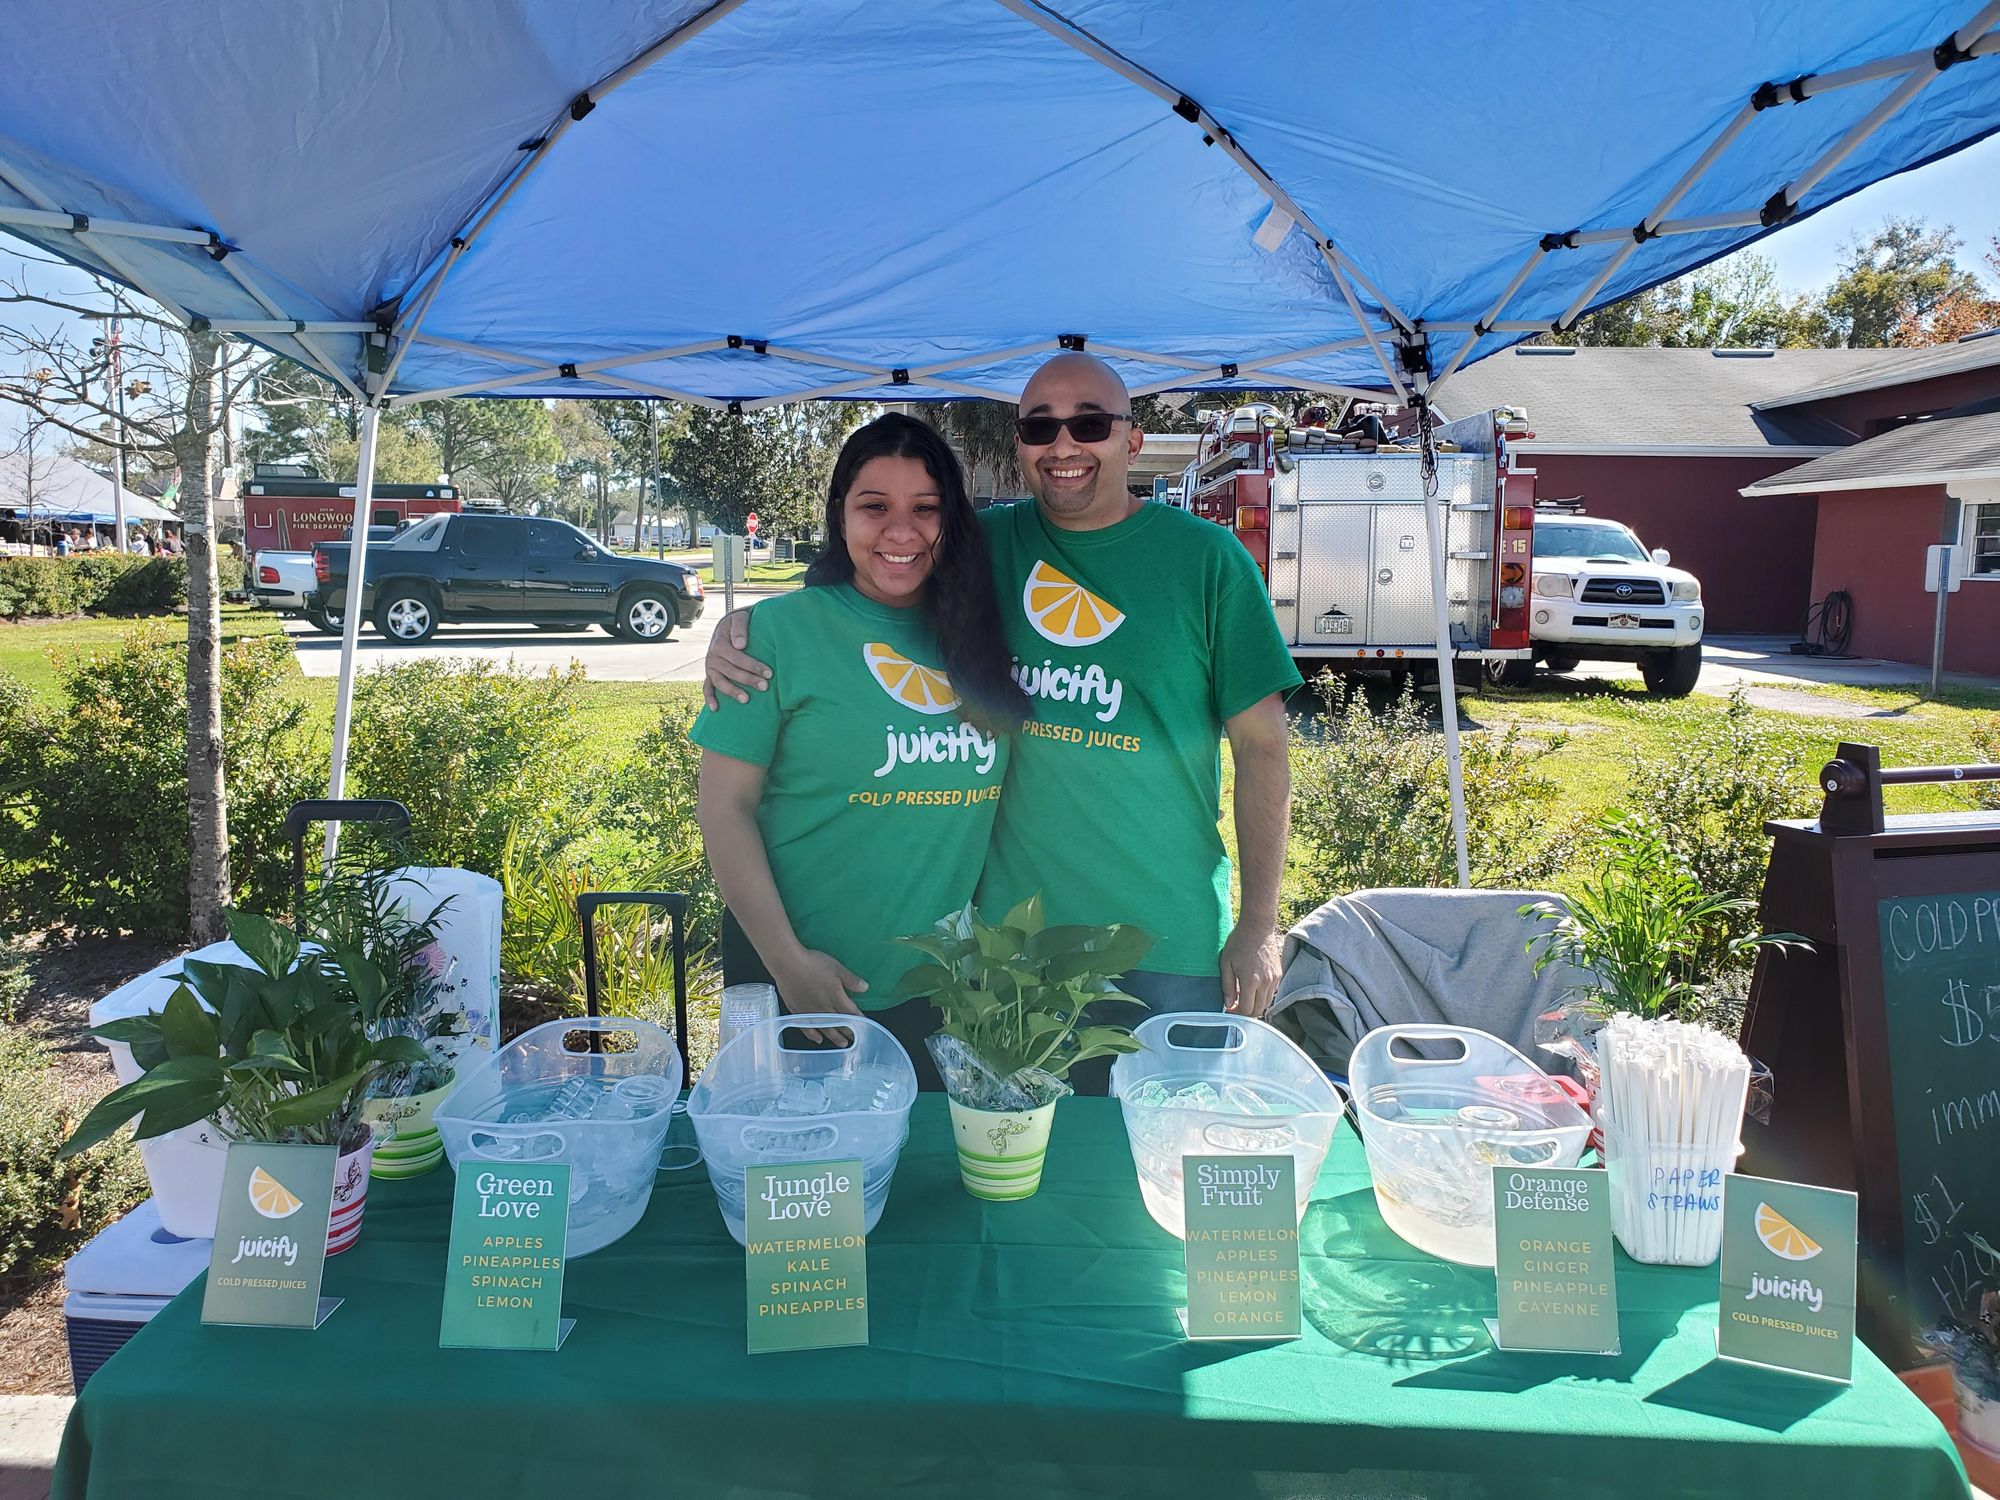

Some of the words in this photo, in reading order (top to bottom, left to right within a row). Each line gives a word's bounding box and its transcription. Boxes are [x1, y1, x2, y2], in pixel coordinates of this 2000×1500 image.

[293, 512, 353, 523] LONGWOO
[1022, 719, 1084, 744] PRESSED
[1085, 730, 1141, 752] JUICES
[873, 721, 996, 778] juicify
[848, 791, 893, 807] COLD
[895, 790, 963, 806] PRESSED
[1889, 901, 1968, 961] COLD
[1939, 977, 2000, 1046] $5
[476, 1172, 554, 1196] Green
[760, 1172, 850, 1201] Jungle
[1197, 1164, 1281, 1190] Simply
[1509, 1173, 1588, 1198] Orange
[1654, 1167, 1720, 1188] PAPER
[1200, 1185, 1263, 1206] Fruit
[1505, 1191, 1590, 1212] Defense
[1648, 1192, 1720, 1211] STRAWS
[478, 1195, 541, 1219] Love
[768, 1199, 832, 1220] Love
[1913, 1173, 1965, 1245] $1
[483, 1236, 544, 1249] APPLES
[747, 1235, 865, 1255] WATERMELON
[1185, 1229, 1298, 1242] WATERMELON
[231, 1235, 298, 1266] juicify
[1215, 1249, 1278, 1262] APPLES
[1519, 1239, 1592, 1254] ORANGE
[463, 1255, 561, 1269] PINEAPPLES
[787, 1258, 830, 1273] KALE
[1524, 1259, 1589, 1274] GINGER
[217, 1277, 241, 1287] COLD
[242, 1278, 278, 1288] PRESSED
[279, 1280, 308, 1290] JUICES
[471, 1275, 543, 1289] SPINACH
[1196, 1270, 1298, 1283] PINEAPPLES
[770, 1278, 847, 1295] SPINACH
[1513, 1280, 1609, 1295] PINEAPPLE
[1745, 1271, 1823, 1313] juicify
[477, 1296, 533, 1308] LEMON
[759, 1297, 865, 1316] PINEAPPLES
[1220, 1291, 1277, 1303] LEMON
[1213, 1311, 1284, 1324] ORANGE
[1518, 1301, 1600, 1316] CAYENNE
[1731, 1311, 1760, 1324] COLD
[1761, 1316, 1804, 1333] PRESSED
[1805, 1325, 1839, 1340] JUICES
